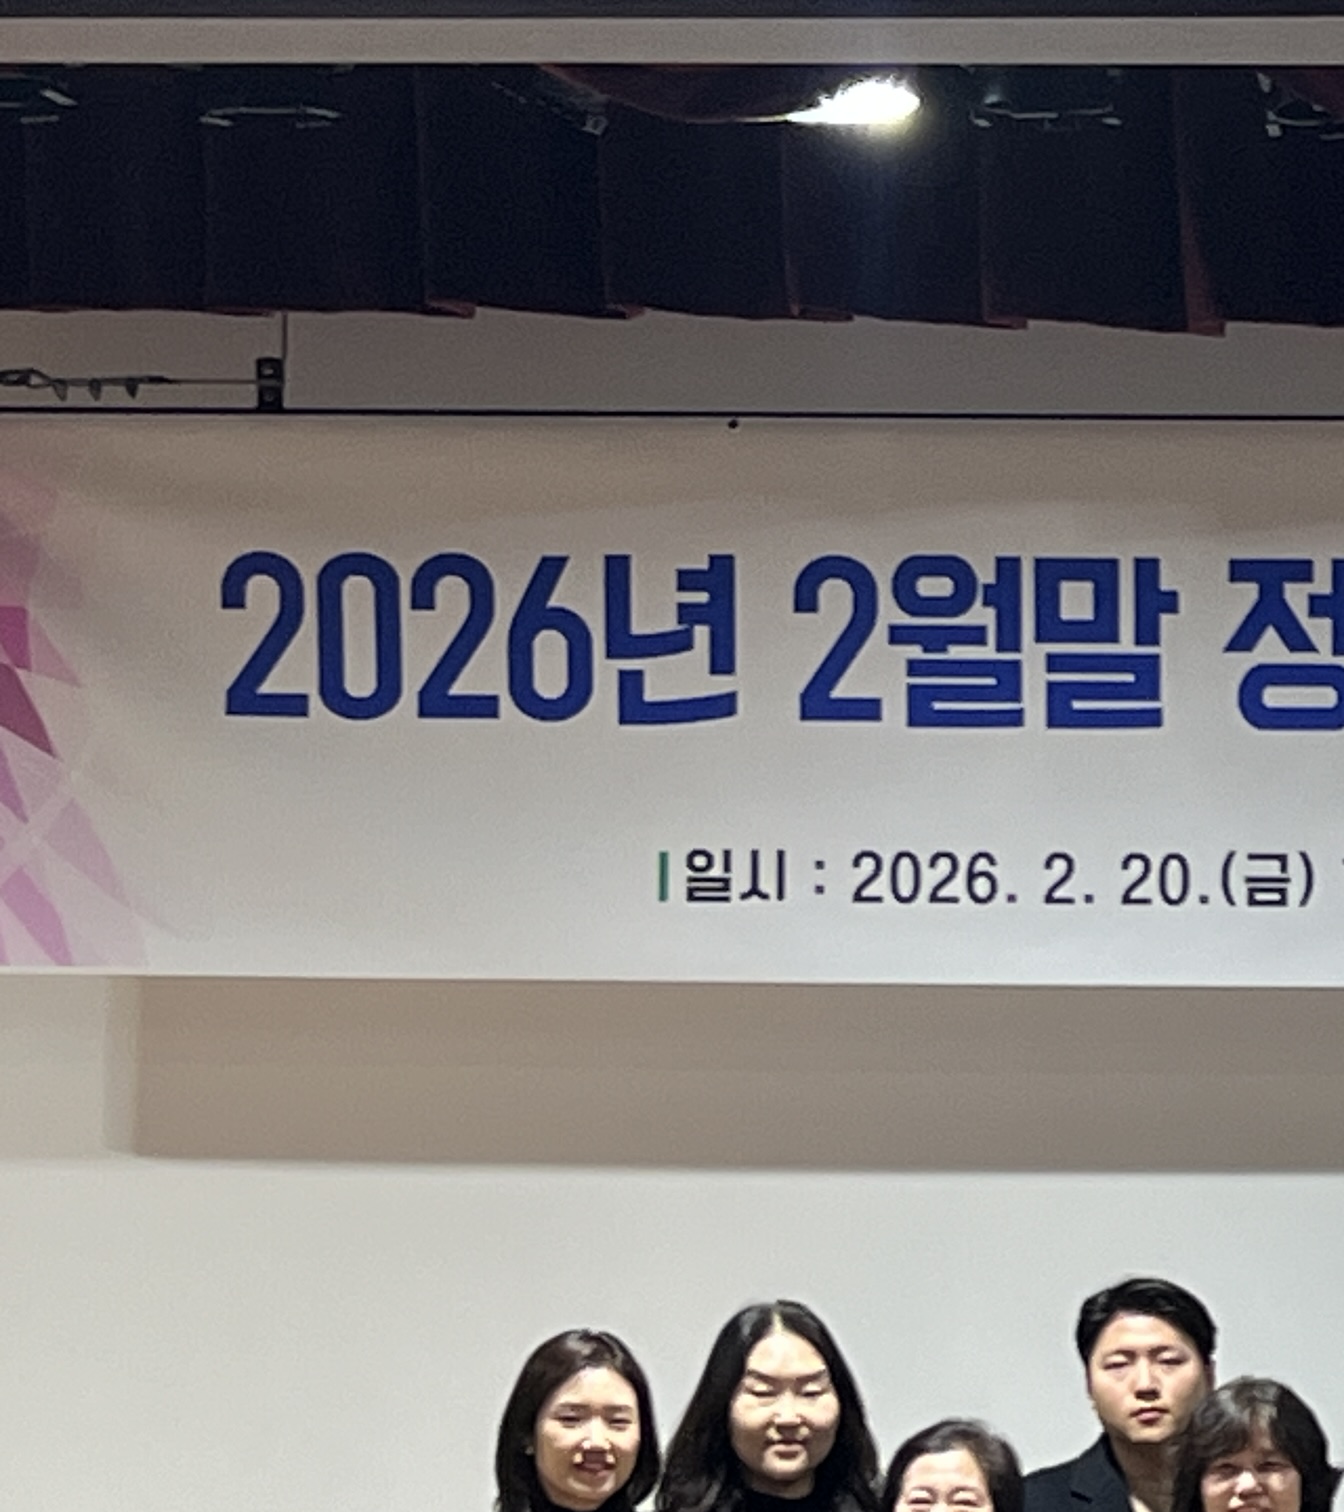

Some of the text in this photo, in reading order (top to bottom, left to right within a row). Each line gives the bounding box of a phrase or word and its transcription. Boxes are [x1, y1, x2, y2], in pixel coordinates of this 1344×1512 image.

[221, 552, 737, 725] 2026년
[793, 556, 1180, 730] 2월말
[685, 848, 786, 904] 일시
[815, 860, 825, 895] :
[852, 850, 1017, 905] 2026.
[1044, 852, 1094, 905] 2.
[1121, 850, 1314, 908] 20.(금)
